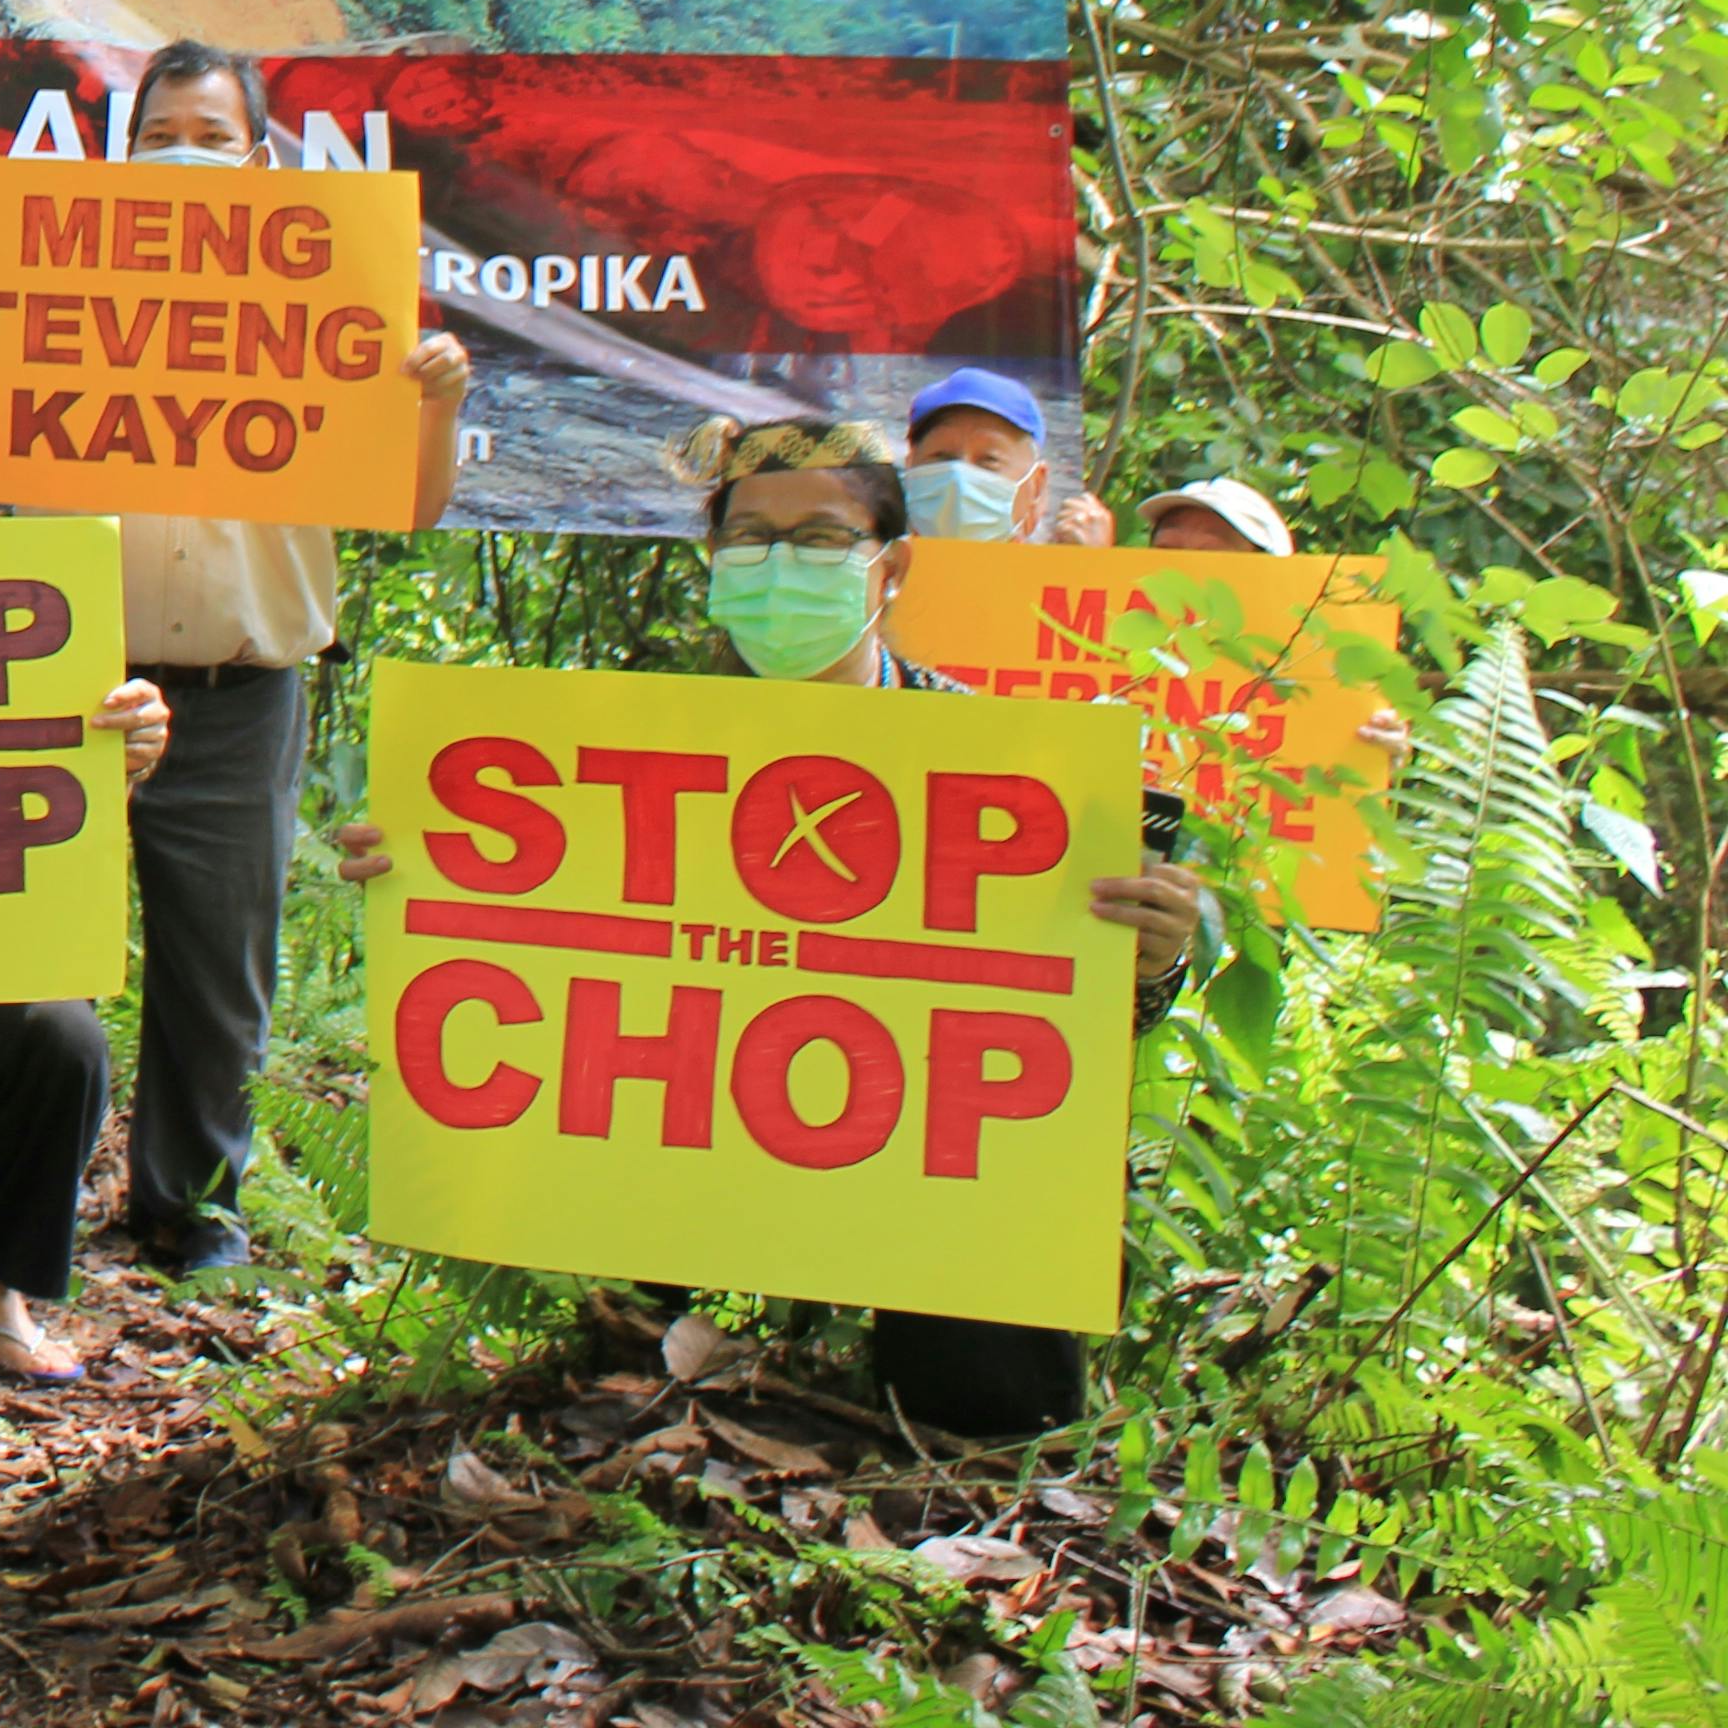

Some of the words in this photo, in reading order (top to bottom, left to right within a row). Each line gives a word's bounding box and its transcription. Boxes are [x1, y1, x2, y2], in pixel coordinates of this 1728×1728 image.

[21, 195, 331, 280] MENG
[418, 247, 706, 312] ROPIKA
[9, 389, 324, 472] KAYO'
[423, 737, 1069, 933] STOP
[680, 924, 788, 966] THE
[395, 958, 1074, 1179] CHOP
